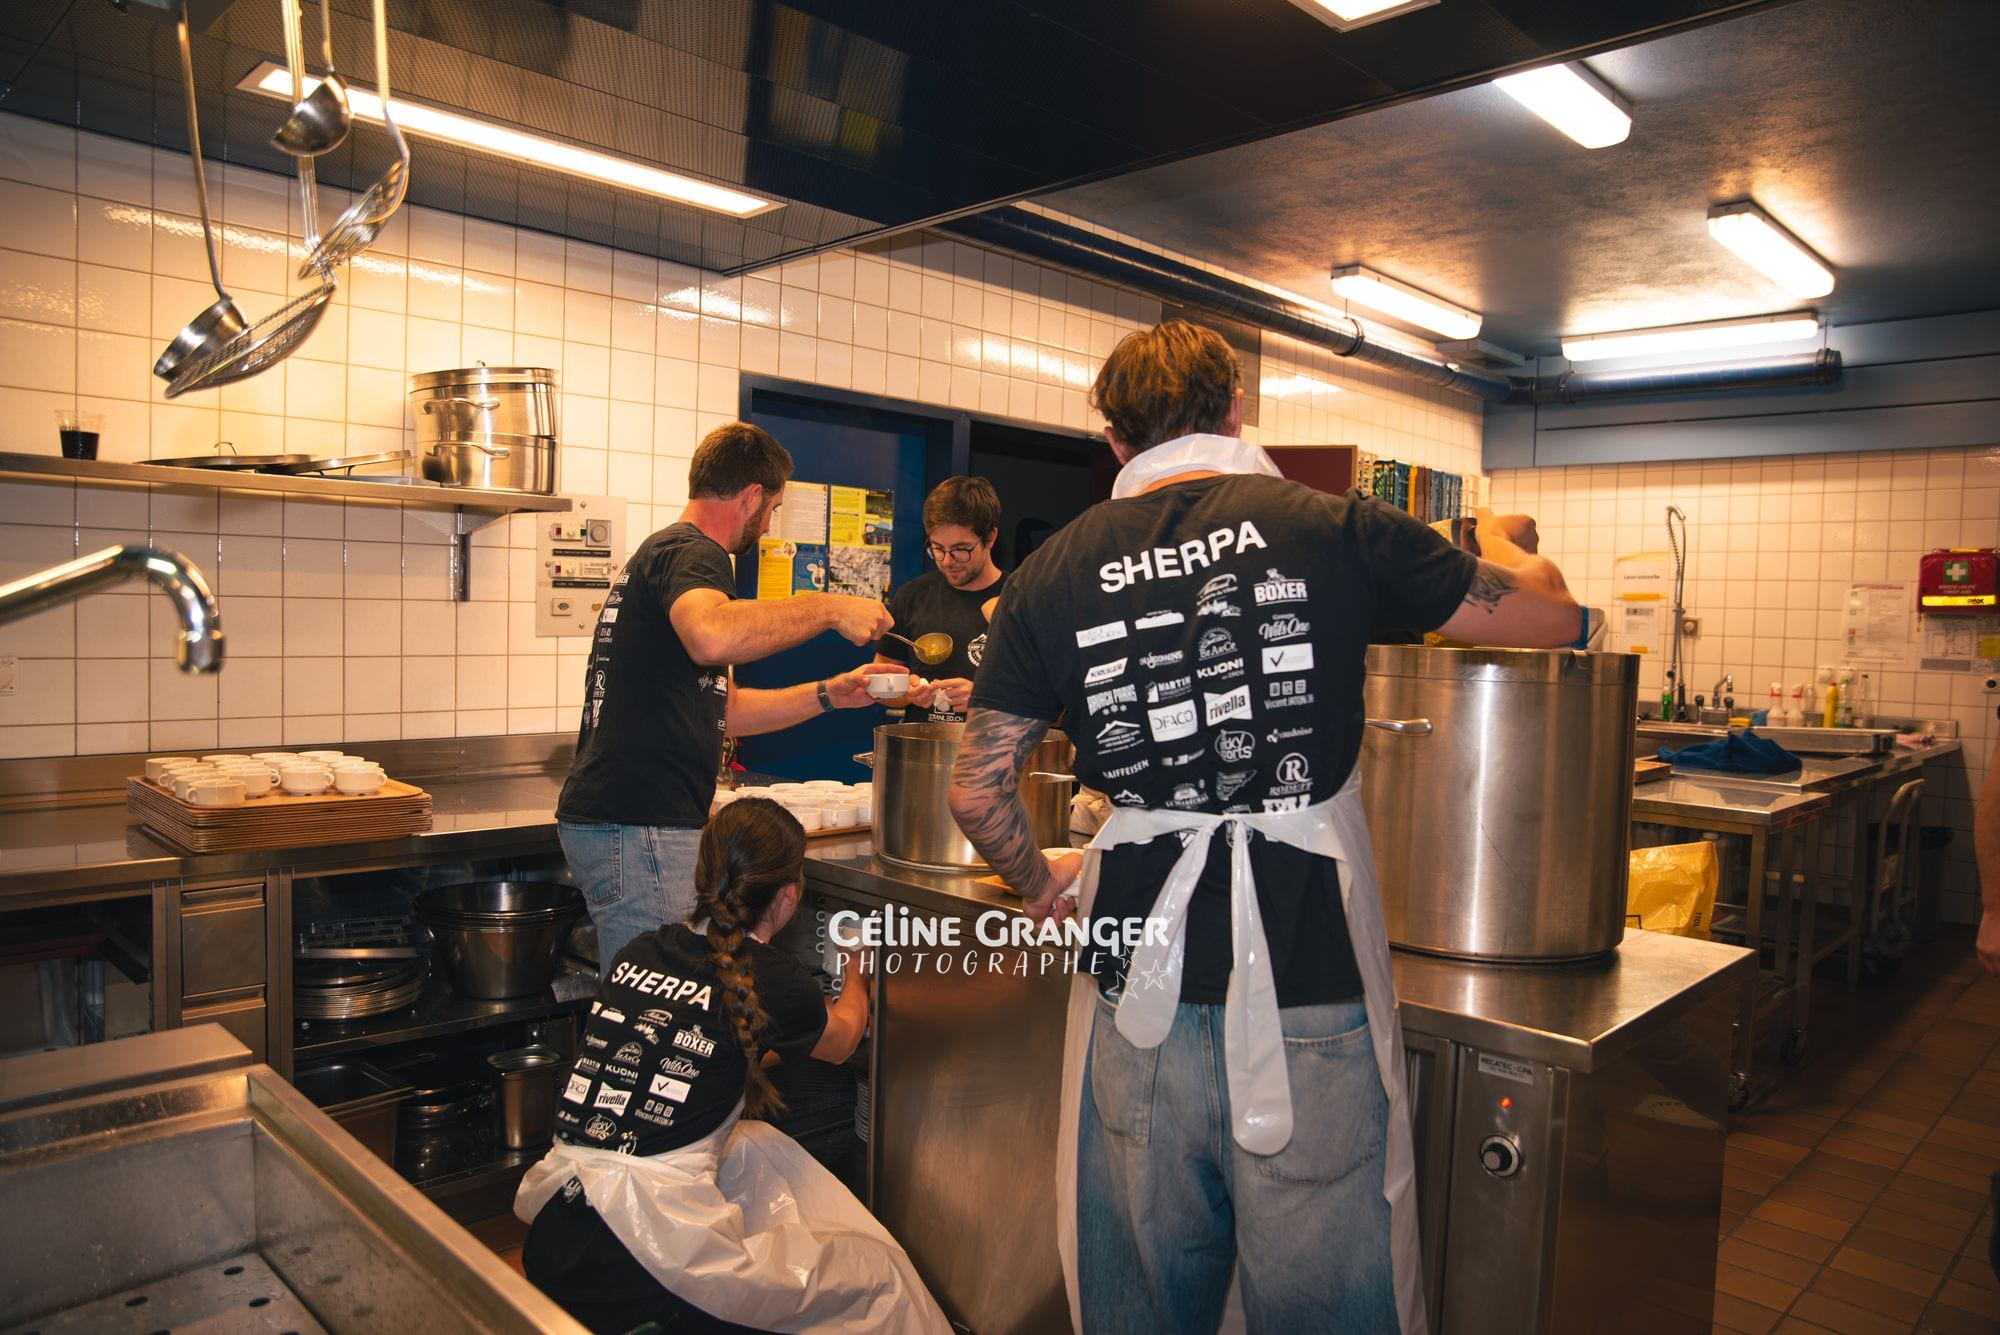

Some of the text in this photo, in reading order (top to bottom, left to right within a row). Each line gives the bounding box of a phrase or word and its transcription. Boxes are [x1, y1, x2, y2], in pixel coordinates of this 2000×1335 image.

[1099, 520, 1268, 593] SHERPA
[1254, 582, 1308, 603] BOXER
[1196, 657, 1244, 679] KUONI
[1209, 694, 1246, 720] rivella
[611, 961, 713, 1012] SHERPA
[673, 1031, 715, 1056] BOXER
[604, 1063, 639, 1080] KUONI
[598, 1091, 627, 1106] rivella
